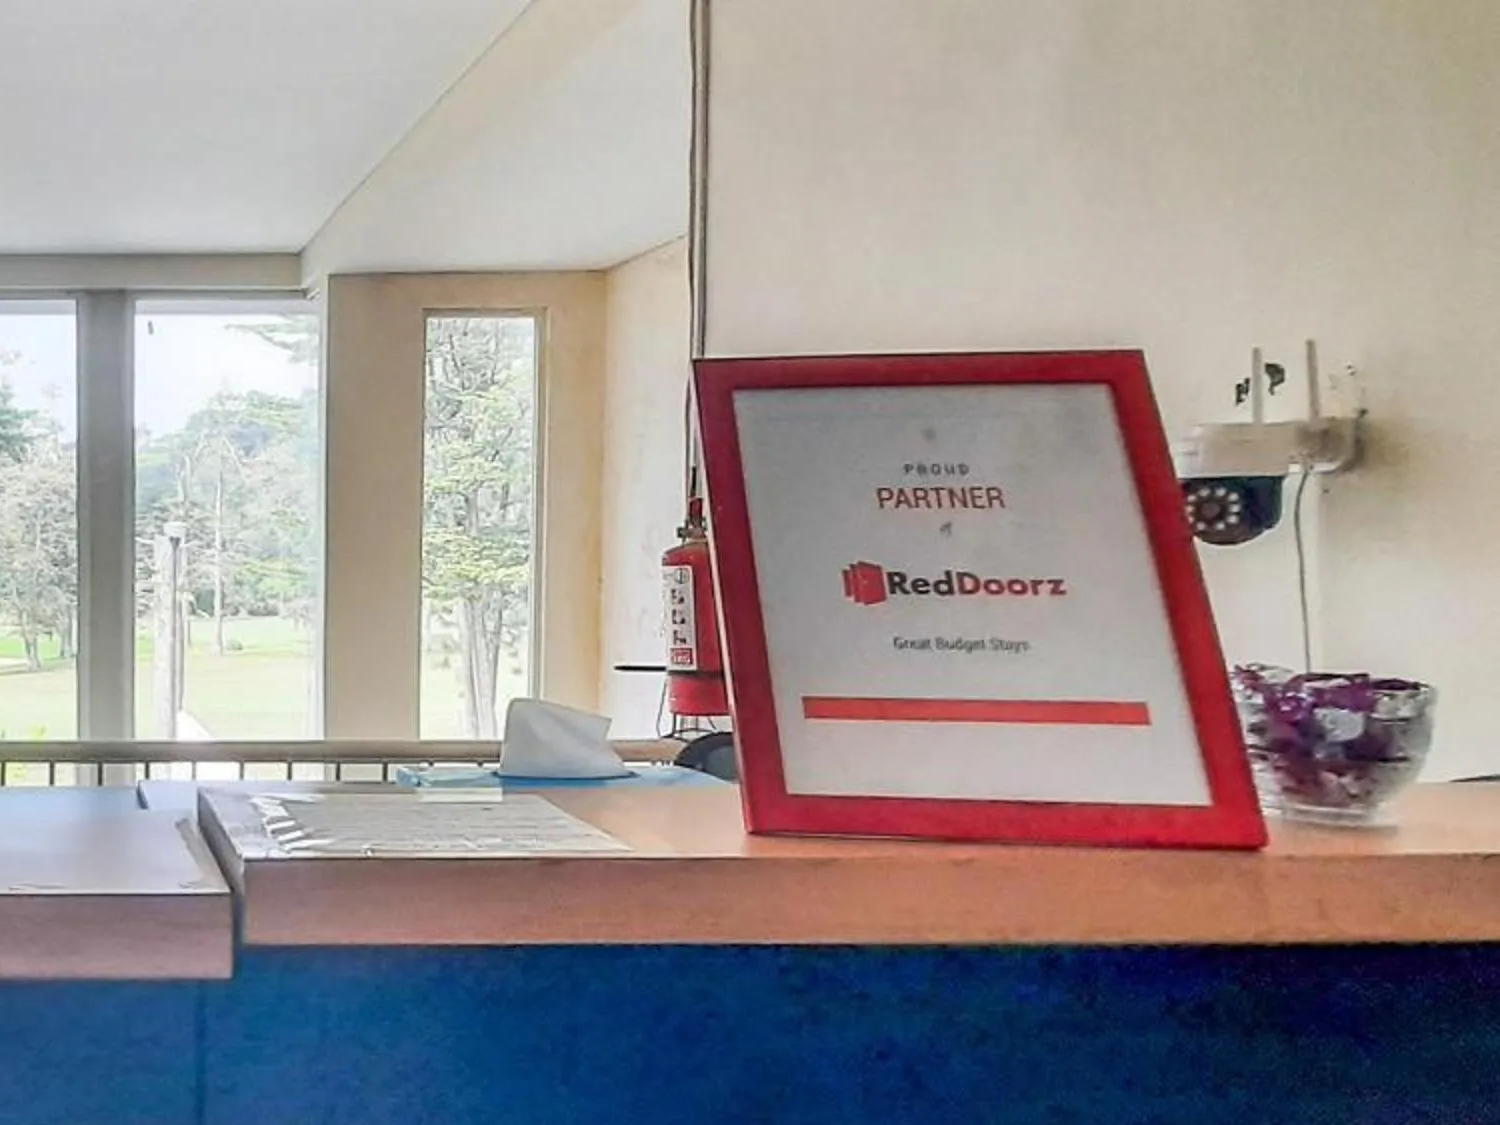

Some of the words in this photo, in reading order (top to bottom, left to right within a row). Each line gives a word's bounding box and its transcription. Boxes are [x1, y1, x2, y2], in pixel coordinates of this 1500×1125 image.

[903, 463, 970, 476] PROUD
[876, 487, 1006, 509] PARTNER
[886, 570, 1067, 596] RedDoorz
[893, 637, 931, 650] Great
[935, 637, 986, 653] Budget
[990, 638, 1031, 654] Stays
